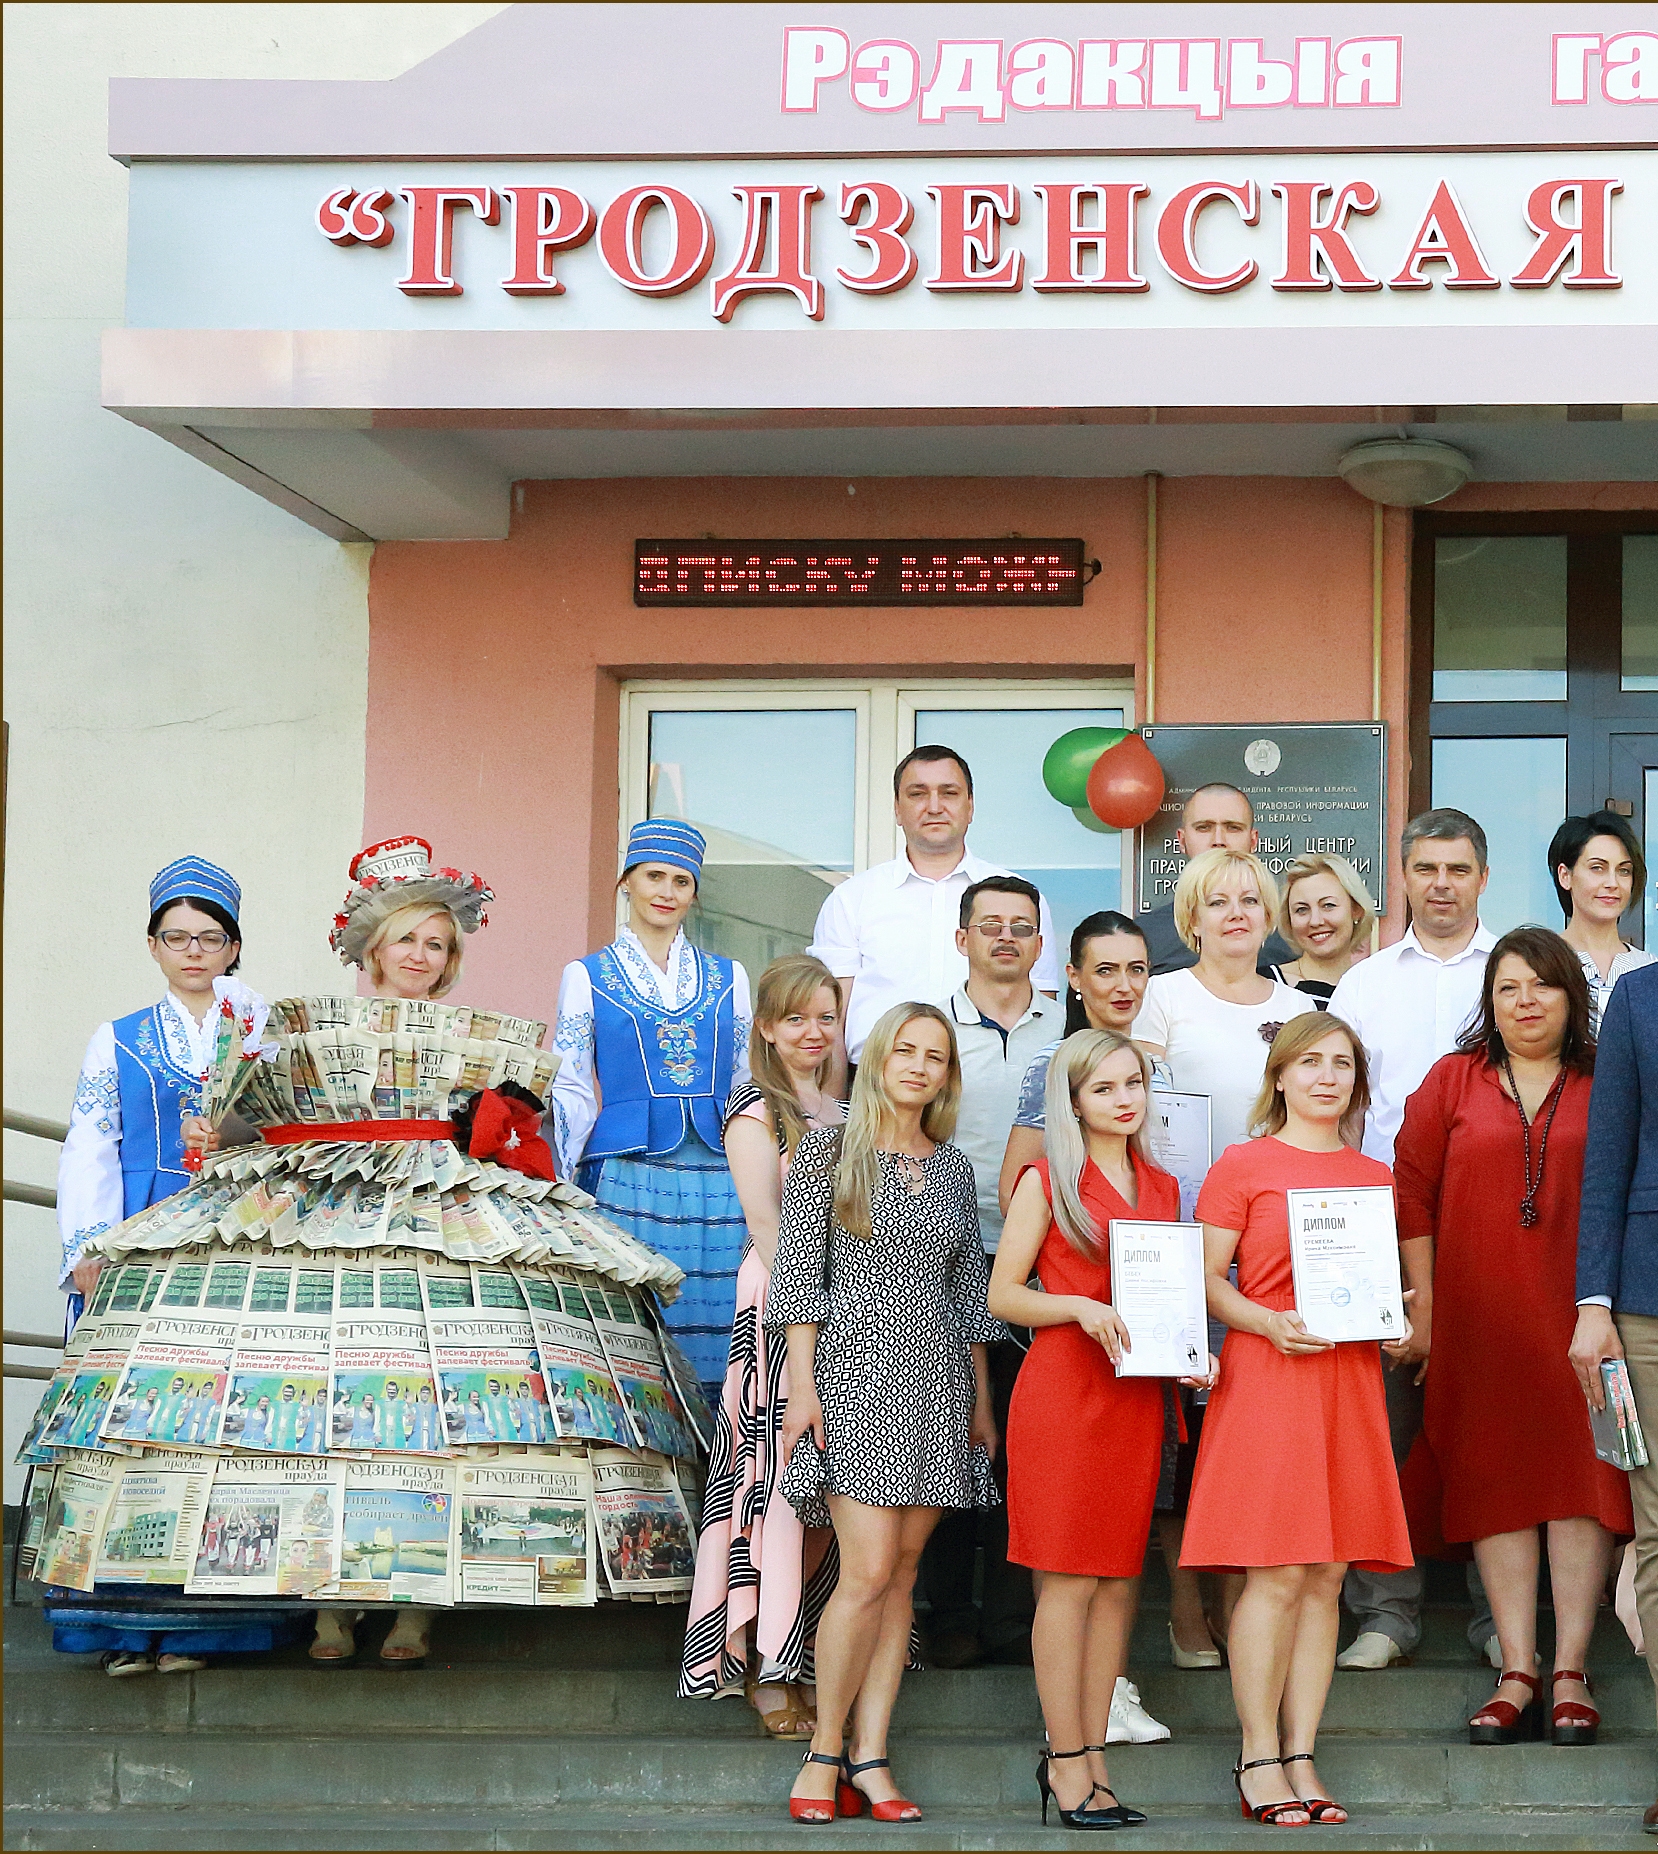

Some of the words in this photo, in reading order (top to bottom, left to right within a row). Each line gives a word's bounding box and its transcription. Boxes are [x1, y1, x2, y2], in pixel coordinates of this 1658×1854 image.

[780, 26, 1403, 123] Рэдакцыя
[1306, 801, 1370, 812] ИНФОРМАЦИИ
[1268, 814, 1313, 823] БЕЛАРУСЬ
[1305, 837, 1356, 853] ЦЕНТР
[1303, 1217, 1346, 1232] ДИПЛОМ
[1123, 1250, 1161, 1264] ДИПЛОМ
[237, 1352, 272, 1361] Песню
[273, 1354, 316, 1363] дружбы
[335, 1351, 371, 1359] Песню
[372, 1351, 415, 1361] дружбы
[470, 1349, 509, 1358] дружбы
[235, 1362, 281, 1370] запевает
[335, 1360, 381, 1368] запевает
[474, 1470, 578, 1487] ГРОДЗЕНСКАЯ
